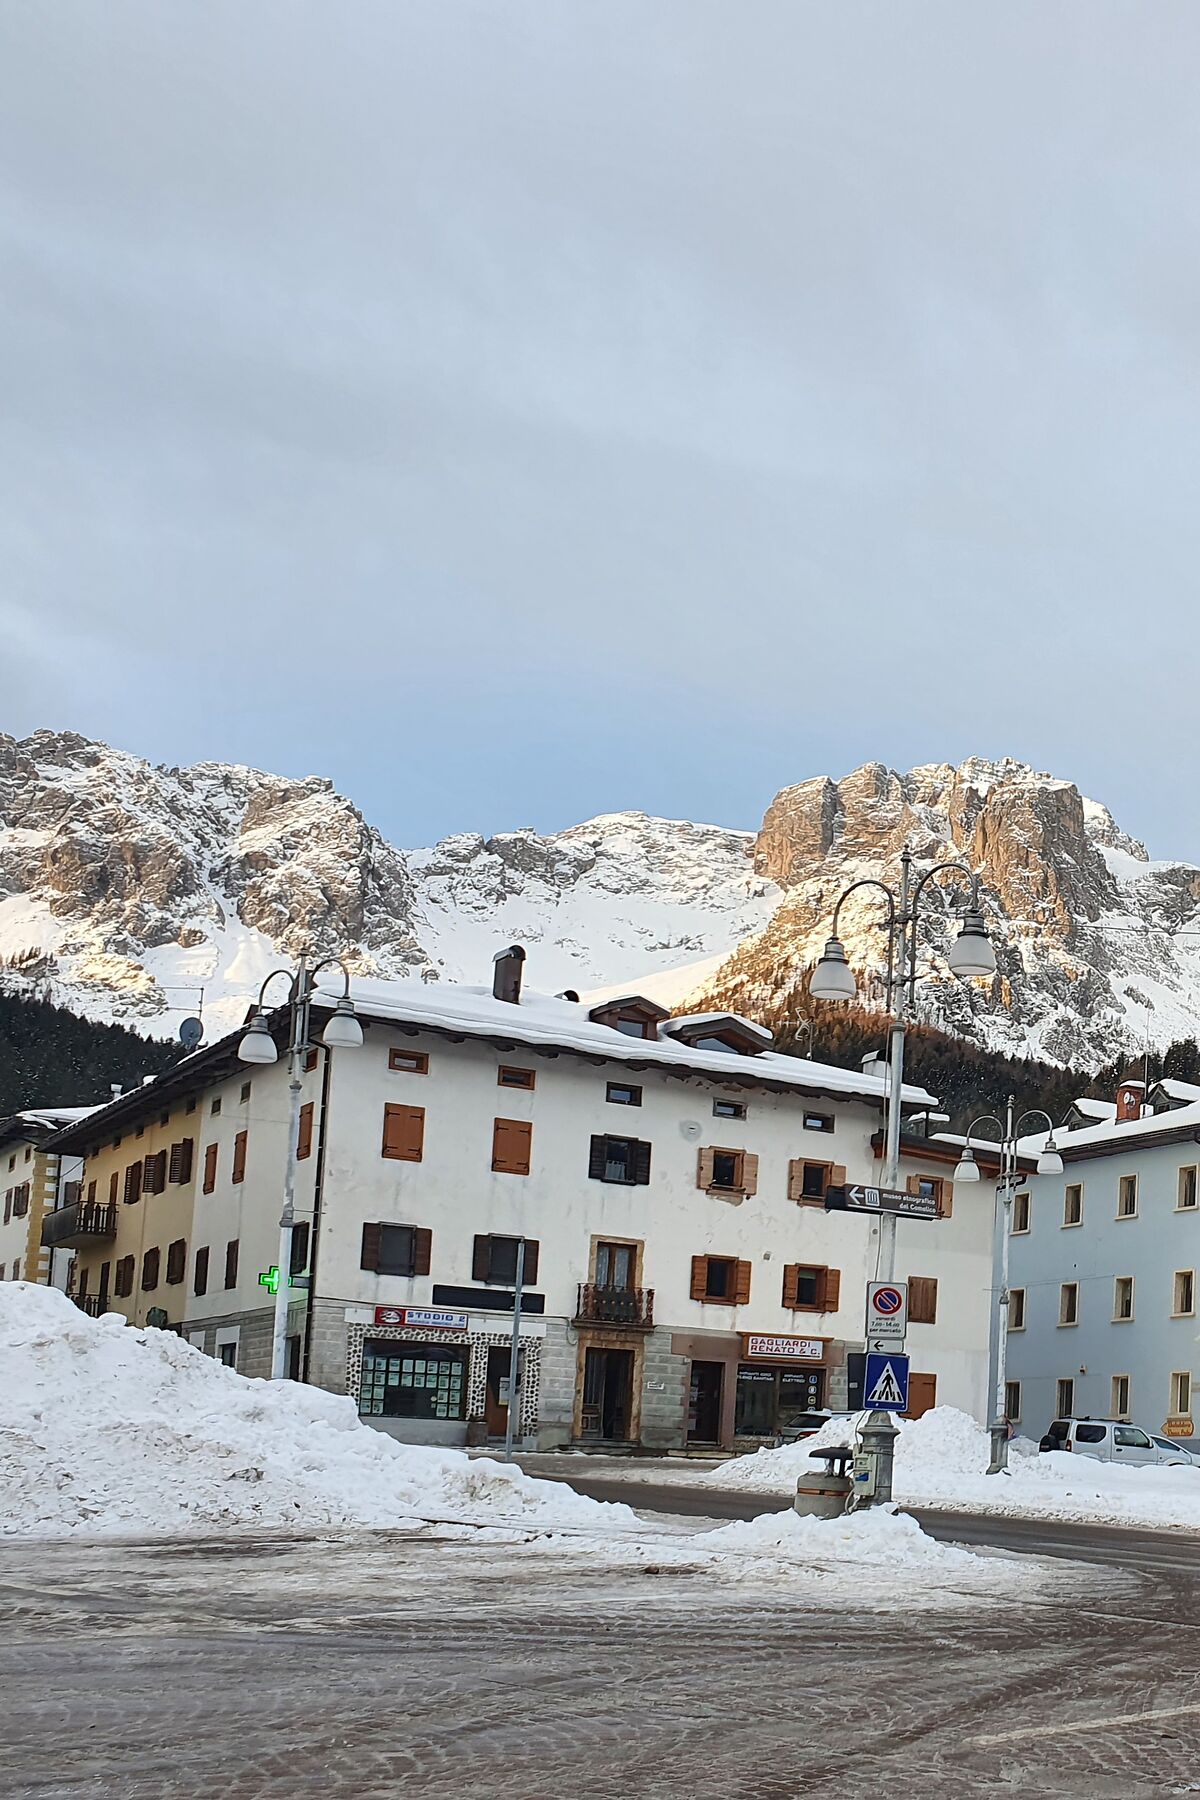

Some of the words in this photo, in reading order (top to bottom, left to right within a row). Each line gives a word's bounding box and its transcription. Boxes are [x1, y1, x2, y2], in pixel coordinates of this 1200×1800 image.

[903, 1195, 936, 1205] etnografico
[910, 1204, 936, 1213] Comelico
[407, 1311, 453, 1321] STUDIO
[750, 1338, 811, 1348] GAGLIARDI
[750, 1345, 795, 1354] RENATO
